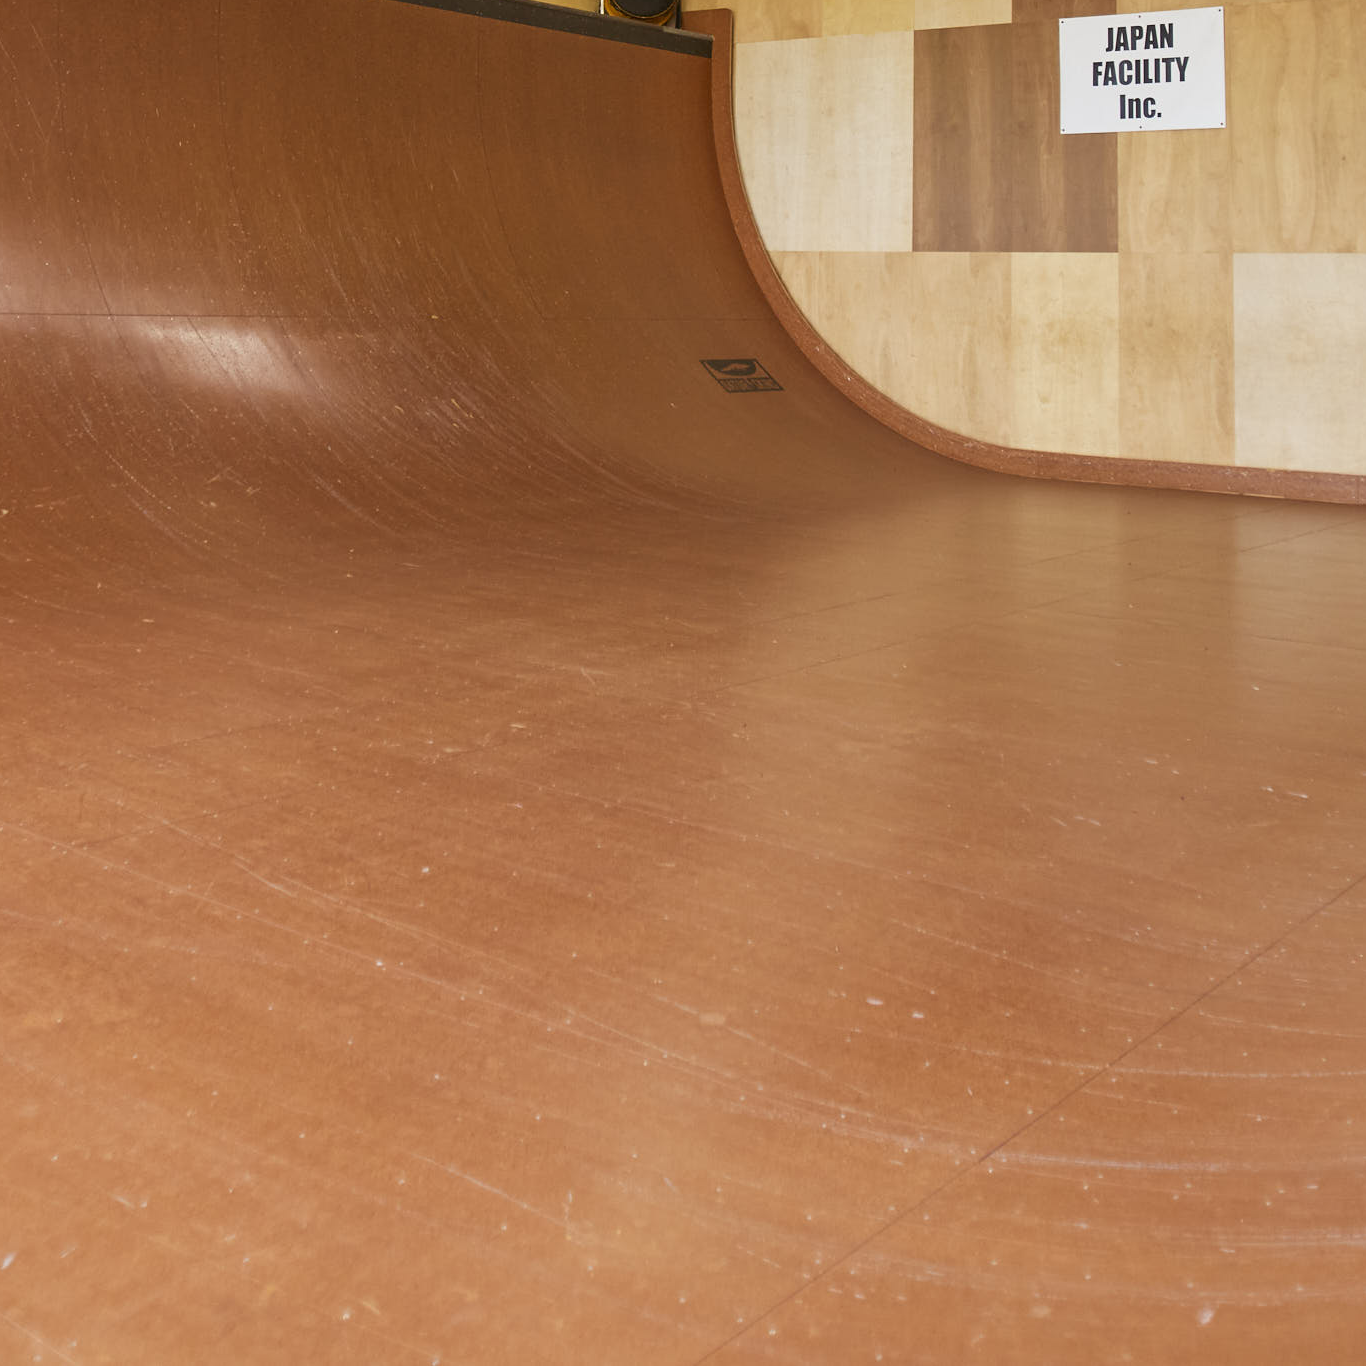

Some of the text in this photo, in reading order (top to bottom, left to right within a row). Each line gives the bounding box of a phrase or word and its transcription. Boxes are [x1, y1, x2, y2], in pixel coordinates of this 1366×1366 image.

[1105, 22, 1174, 53] JAPAN
[1092, 56, 1189, 87] FACILITY
[1119, 94, 1162, 120] Inc.
